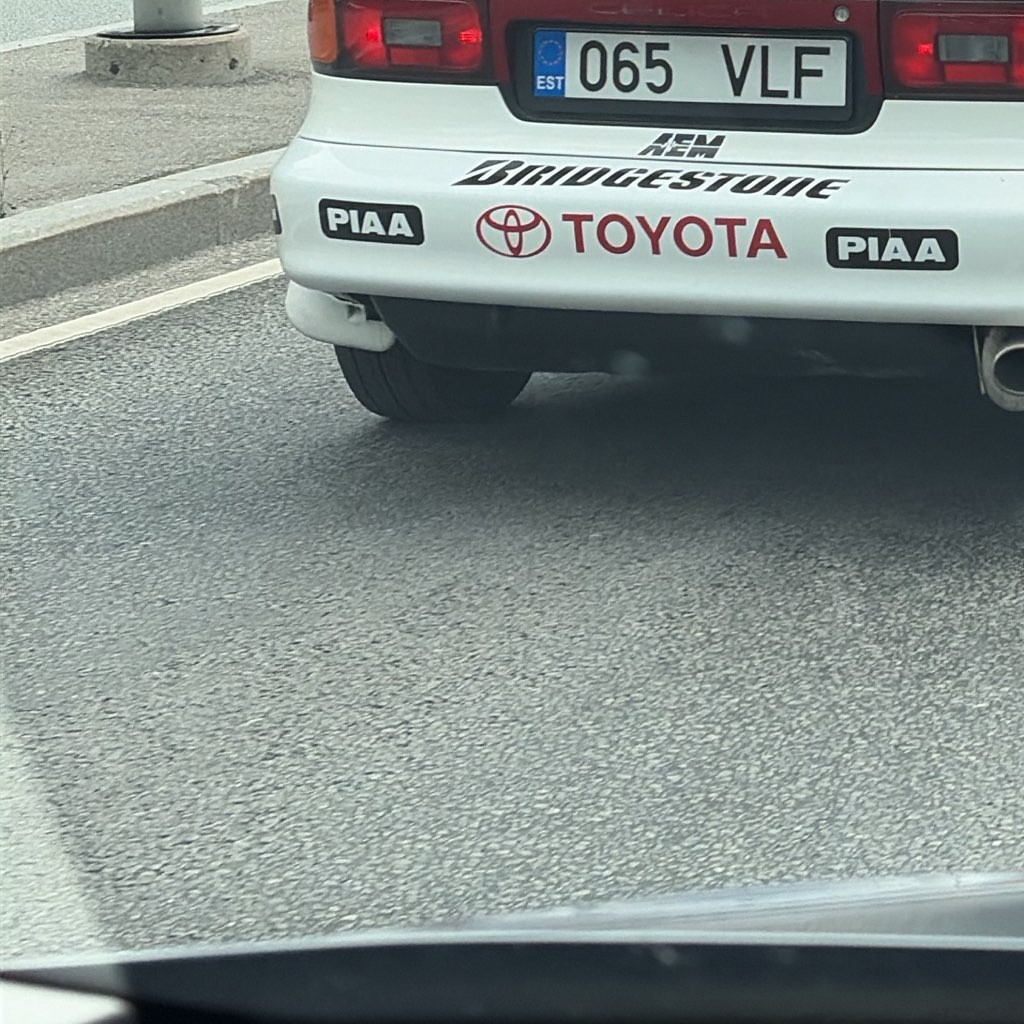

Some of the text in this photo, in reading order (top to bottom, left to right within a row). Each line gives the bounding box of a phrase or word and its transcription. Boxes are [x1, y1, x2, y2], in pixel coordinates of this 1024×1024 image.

[536, 75, 566, 91] EST
[579, 40, 830, 100] 065 VLF
[327, 206, 414, 238] PIAA
[562, 213, 788, 259] TOYOTA
[837, 236, 946, 263] PIAA
